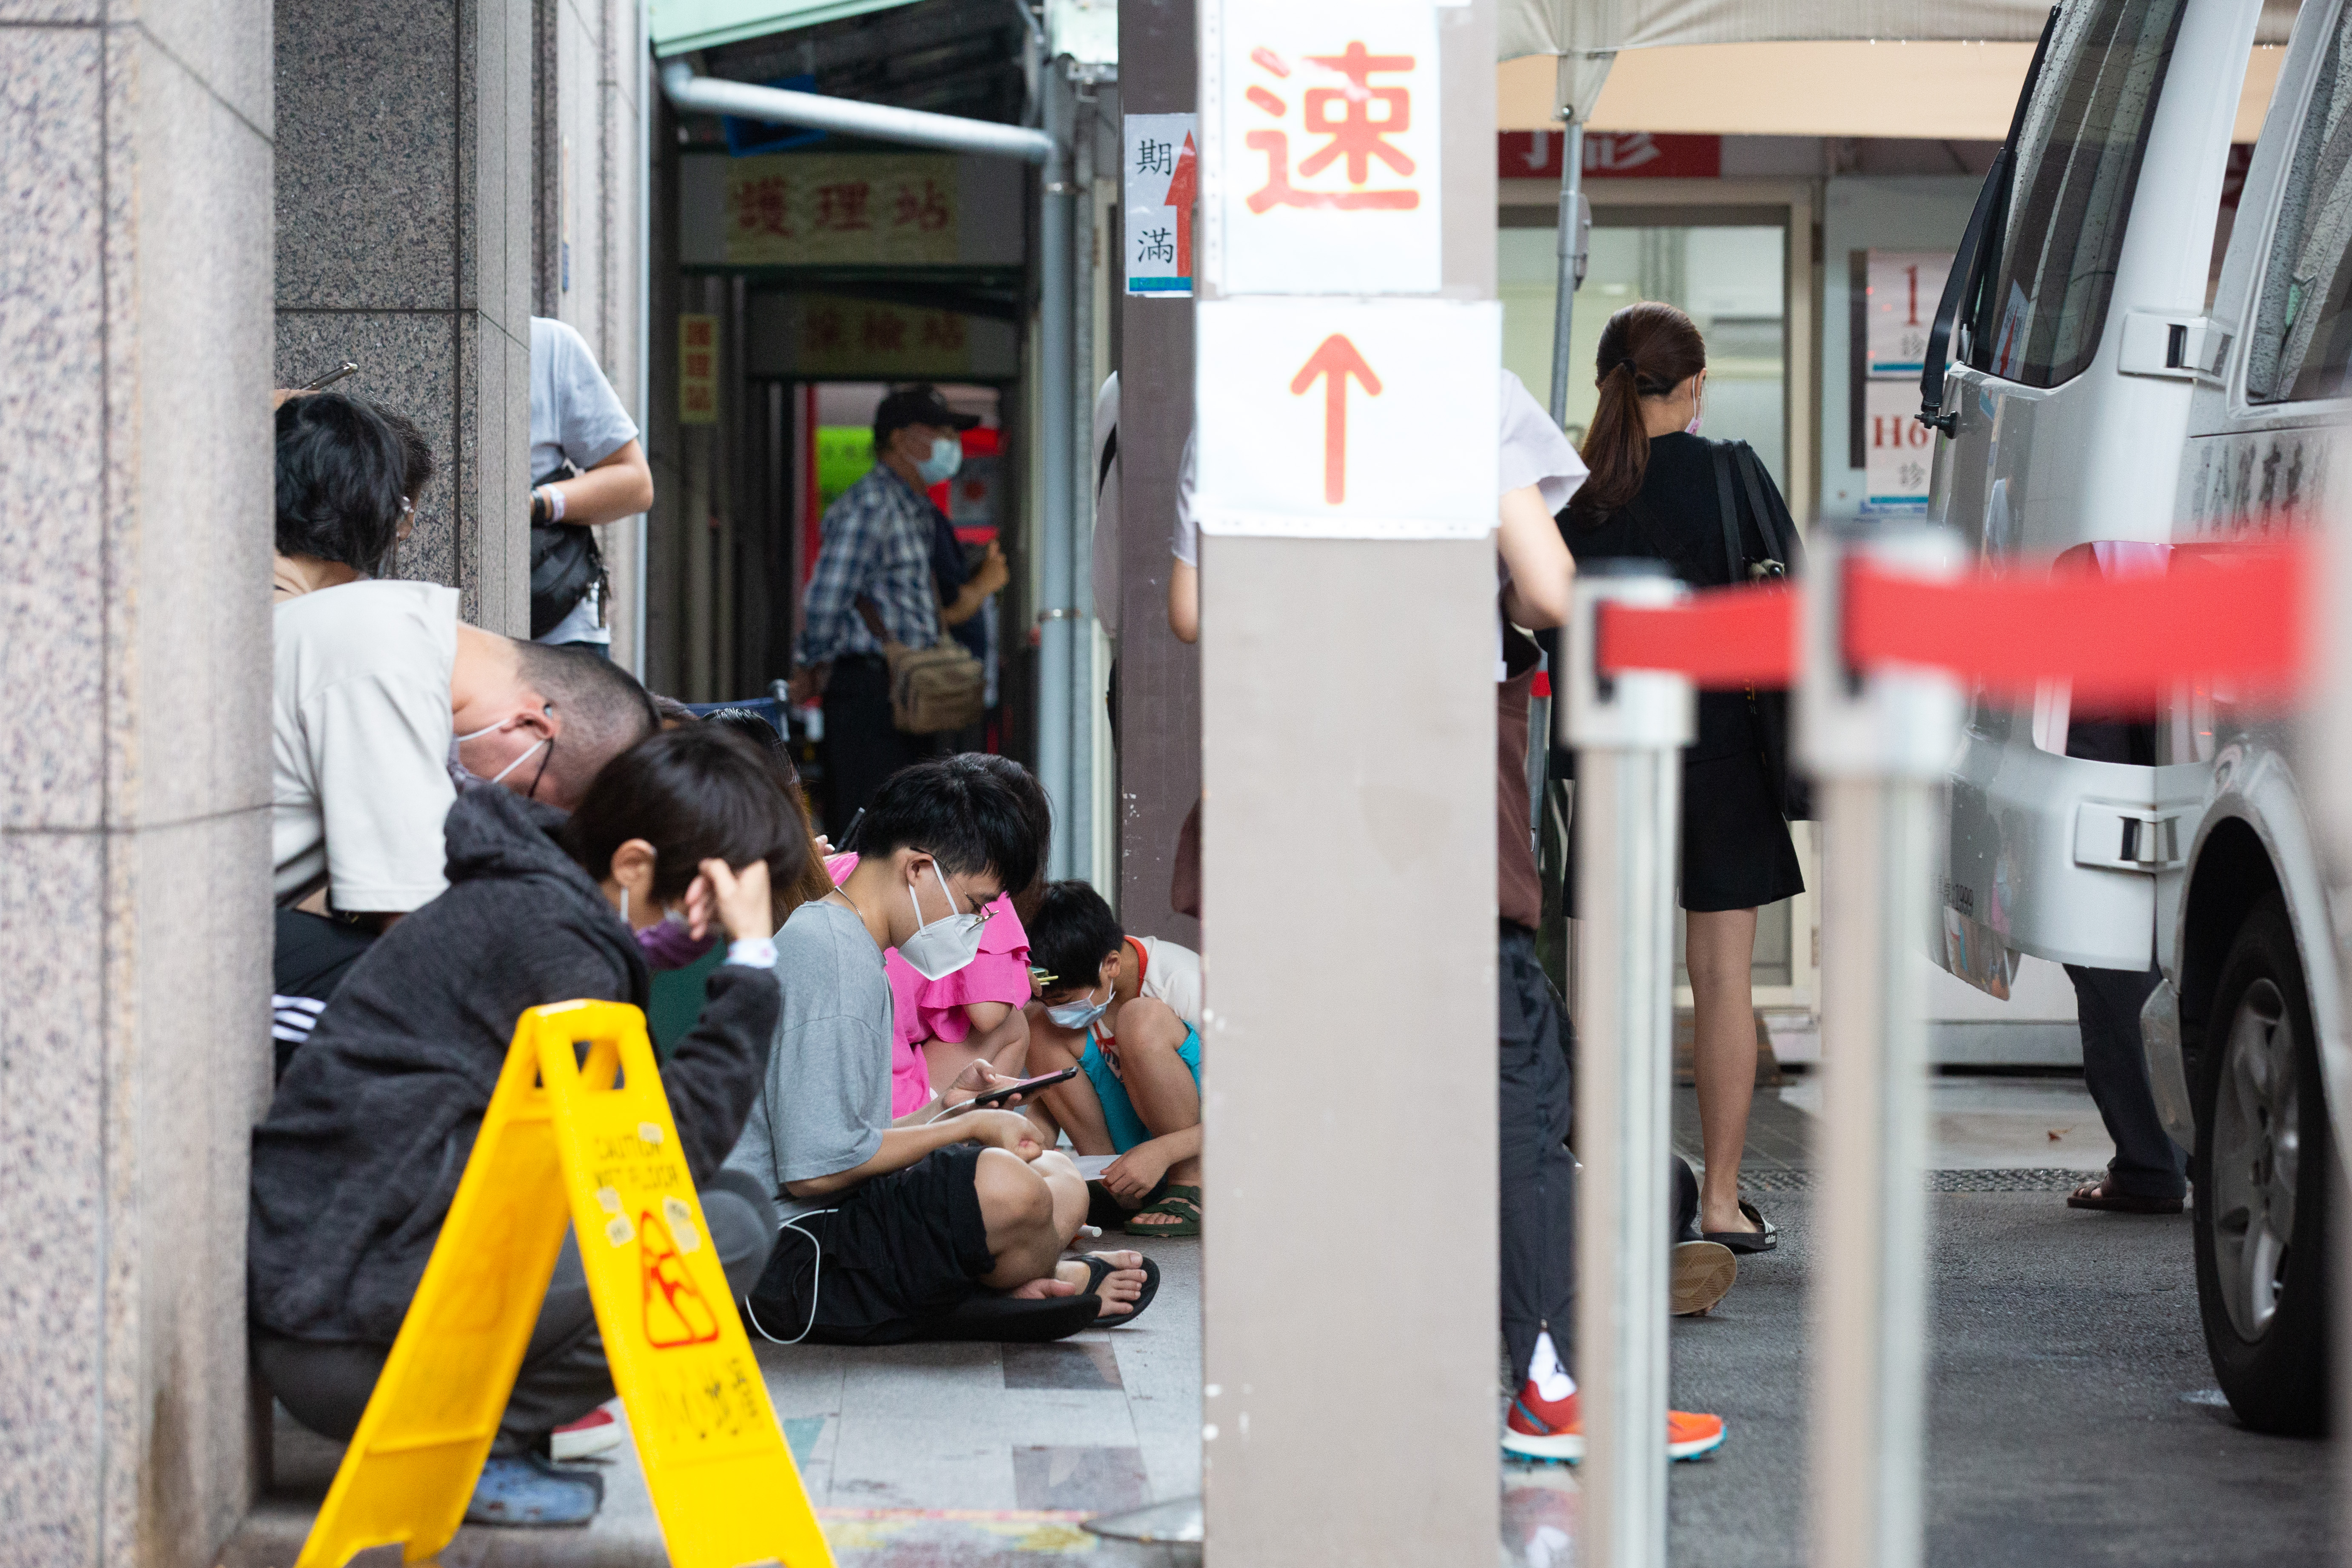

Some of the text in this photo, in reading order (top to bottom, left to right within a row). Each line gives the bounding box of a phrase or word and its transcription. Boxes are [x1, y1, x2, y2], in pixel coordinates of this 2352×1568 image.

[1245, 40, 1420, 214] 速
[736, 175, 950, 238] 護理站
[1904, 265, 1922, 328] 1
